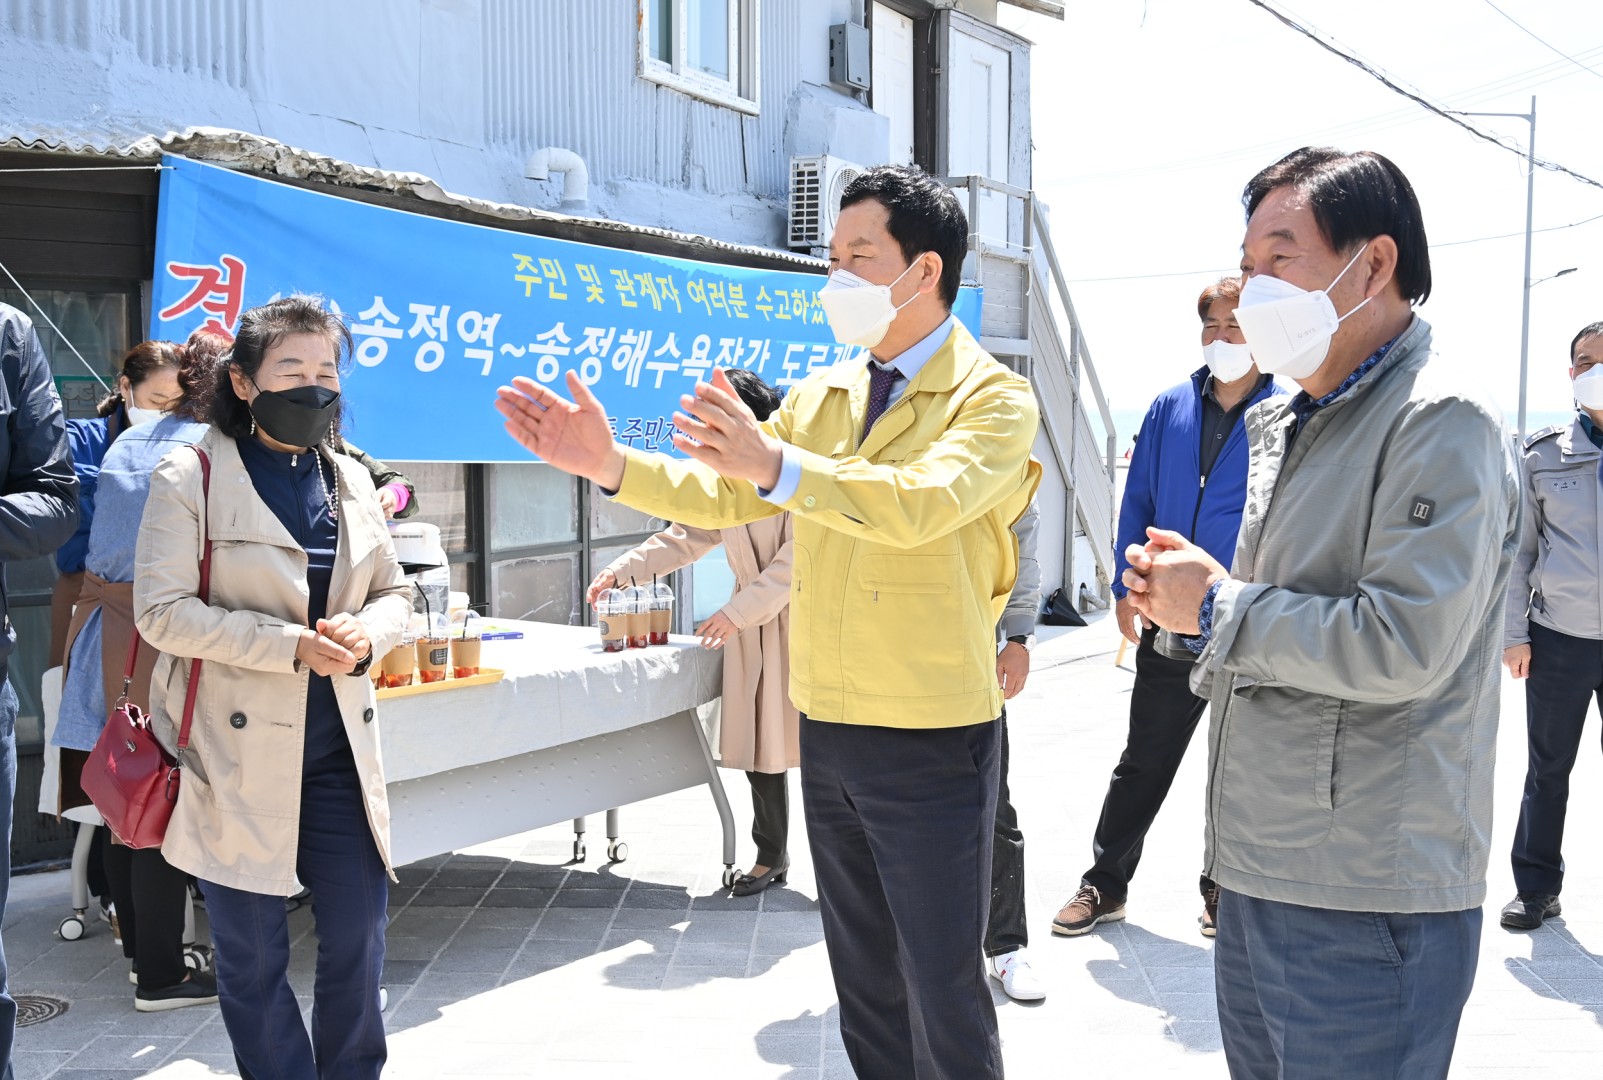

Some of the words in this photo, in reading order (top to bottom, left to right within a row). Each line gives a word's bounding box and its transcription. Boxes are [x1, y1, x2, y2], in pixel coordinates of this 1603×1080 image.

[512, 253, 567, 300] 주민
[575, 263, 605, 304] 및
[610, 269, 682, 313] 관계자
[686, 279, 749, 319] 여러분
[756, 285, 831, 326] 수고하셨
[621, 417, 702, 451] 주민자
